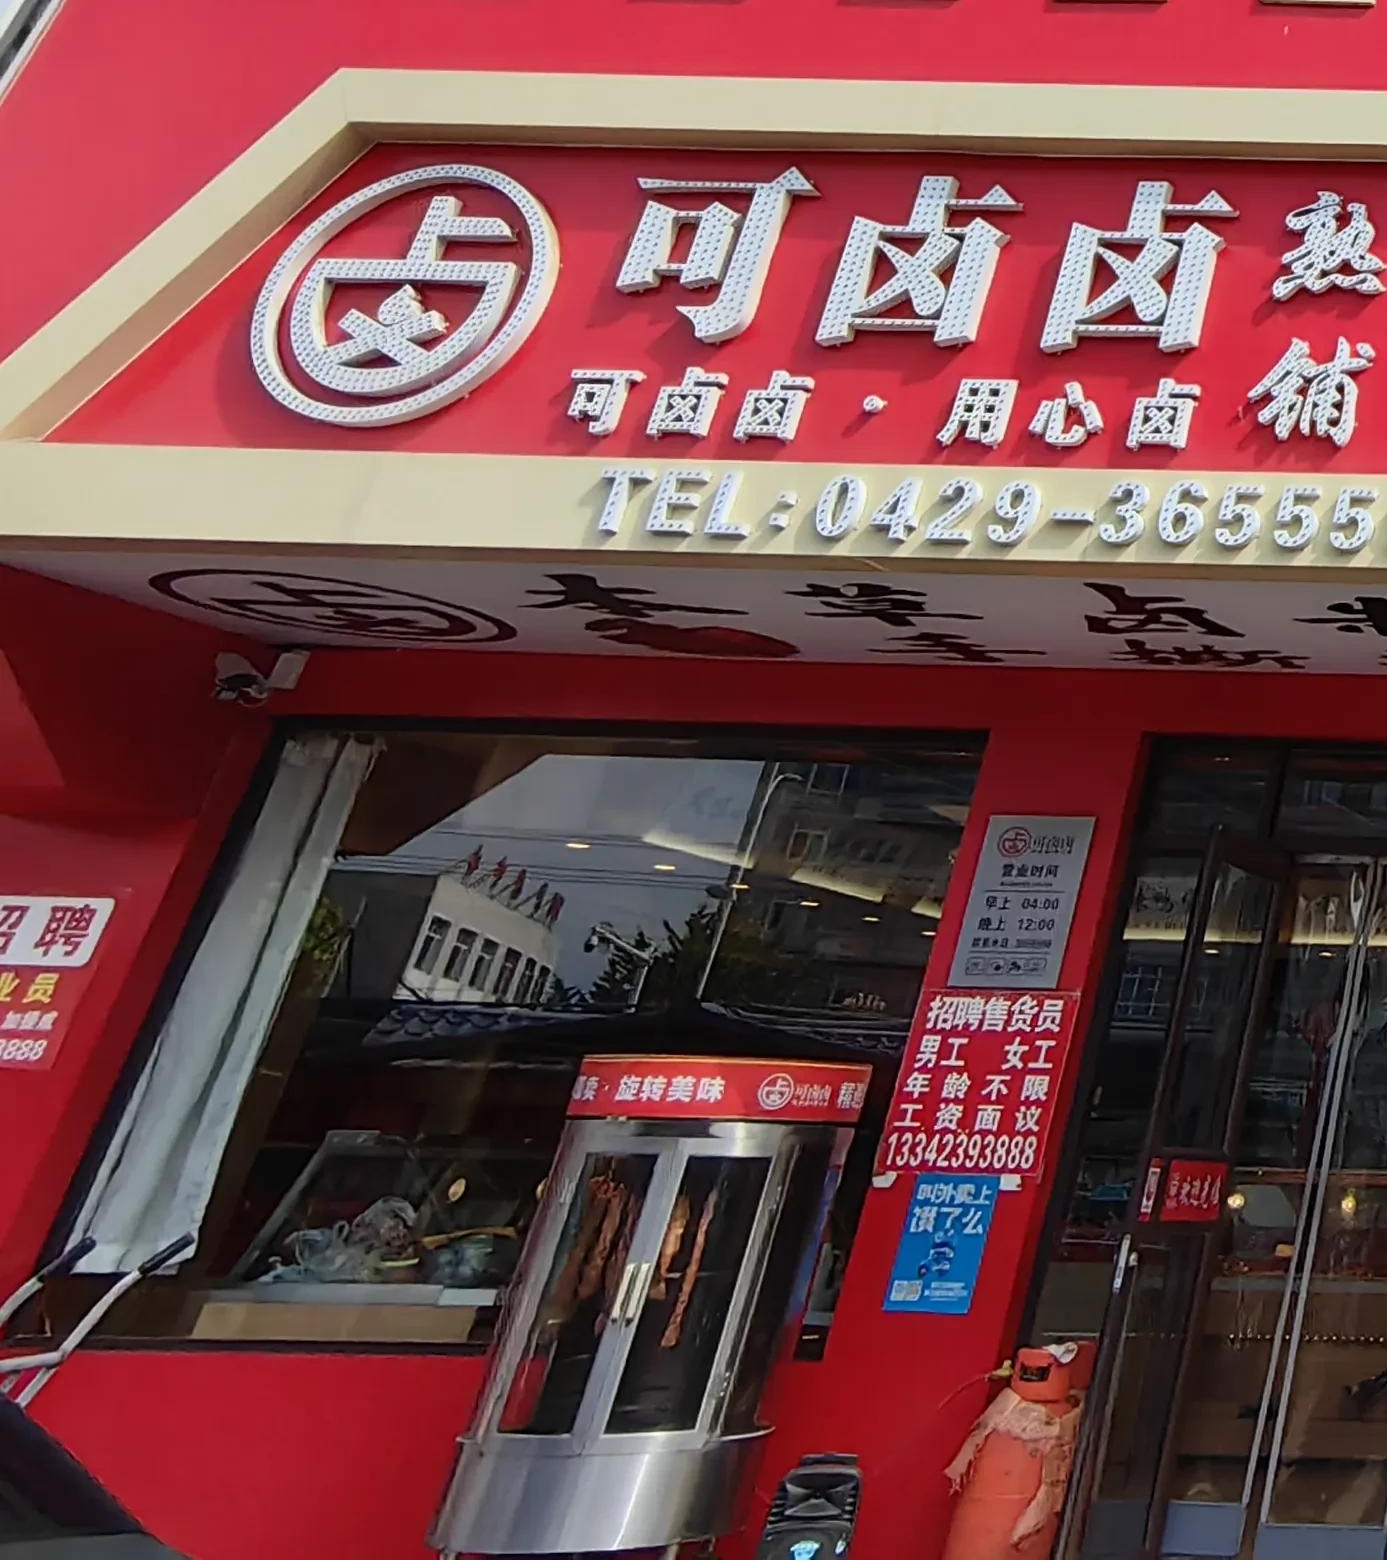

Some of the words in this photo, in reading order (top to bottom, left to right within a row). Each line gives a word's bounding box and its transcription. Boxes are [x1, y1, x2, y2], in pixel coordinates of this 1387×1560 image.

[616, 165, 1239, 354] 可卤卤
[926, 994, 1065, 1033] 招聘售货员
[915, 1034, 969, 1068] 男工
[1001, 1038, 1056, 1070] 女工
[903, 1071, 1050, 1102] 年龄不限
[894, 1102, 1043, 1133] 工资面议
[886, 1132, 1038, 1170] 13342393888
[910, 1206, 985, 1235] 饿了么
